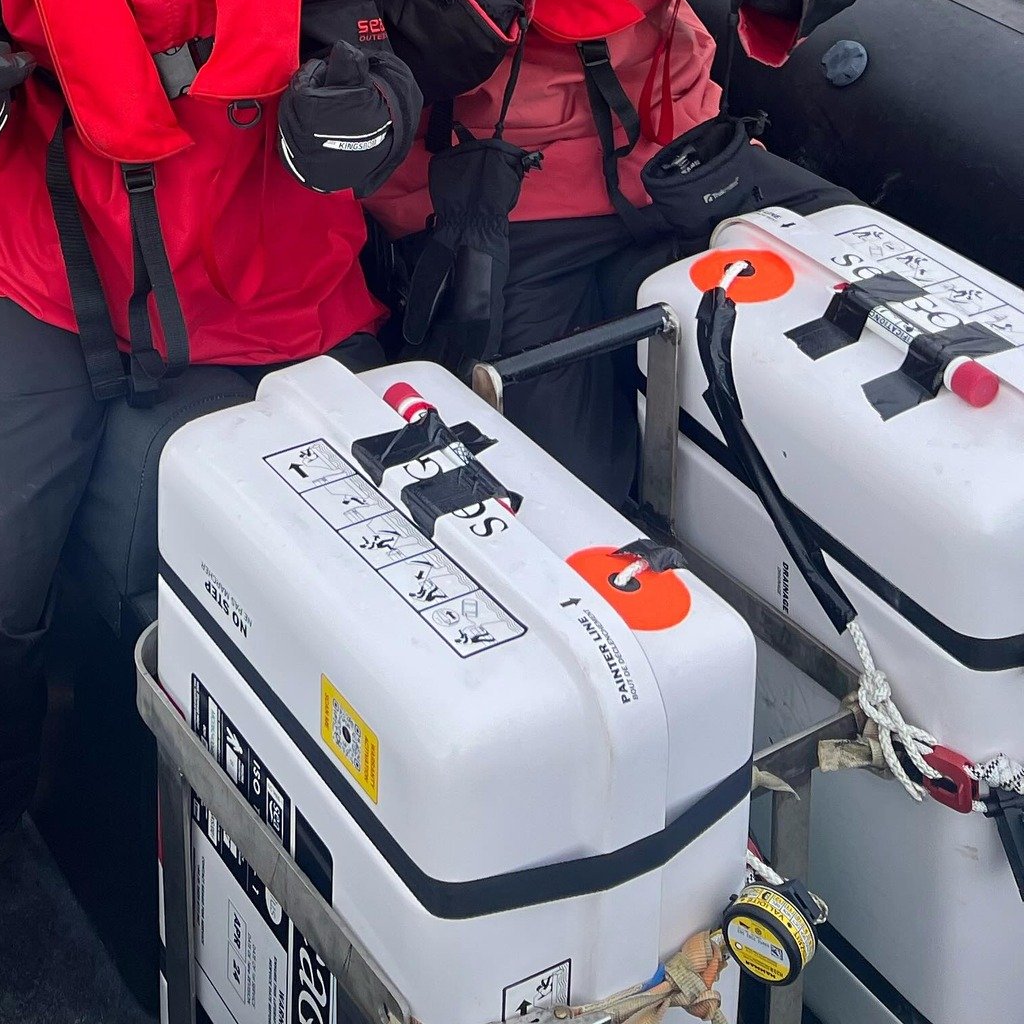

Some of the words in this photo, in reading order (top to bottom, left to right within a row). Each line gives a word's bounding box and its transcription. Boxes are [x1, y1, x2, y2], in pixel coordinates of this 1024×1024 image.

[205, 580, 229, 616] STEP
[233, 611, 247, 638] NO
[578, 616, 602, 642] LINE
[599, 643, 631, 704] PAINTER
